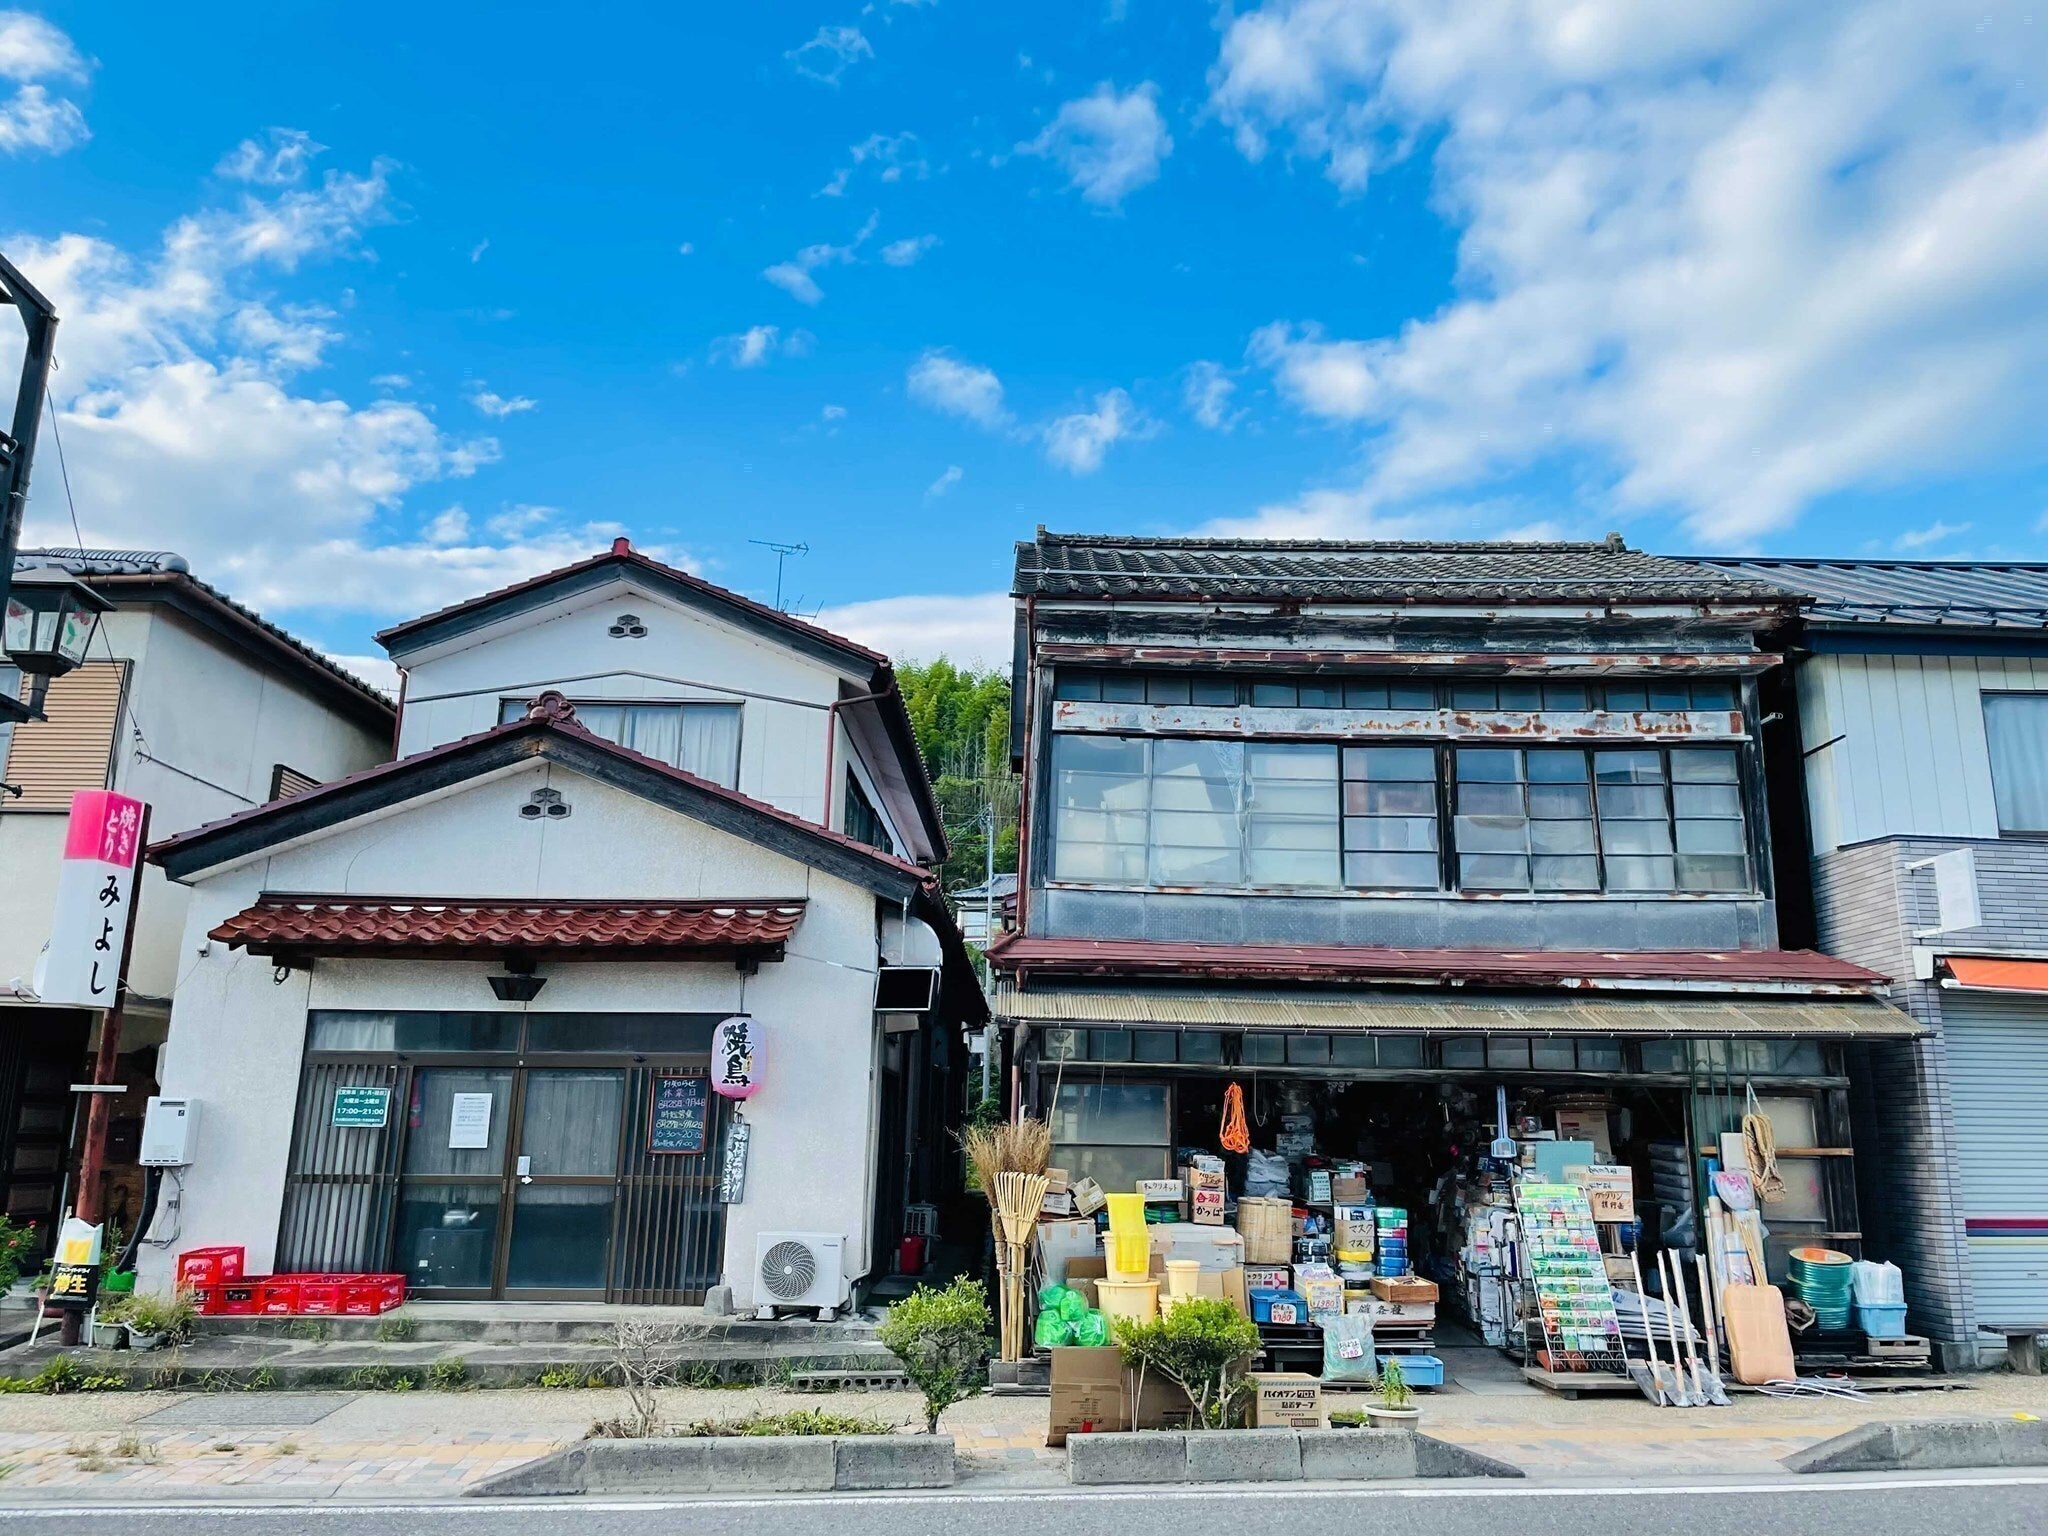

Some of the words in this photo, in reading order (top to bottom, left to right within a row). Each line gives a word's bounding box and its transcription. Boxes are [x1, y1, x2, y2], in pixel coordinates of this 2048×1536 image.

[104, 809, 119, 859] とり
[118, 804, 136, 855] 焼き
[90, 875, 120, 995] みよし
[721, 1022, 754, 1087] 焼鳥
[1196, 1192, 1220, 1203] 合羽
[1595, 1191, 1623, 1200] ガソリン
[1196, 1206, 1223, 1216] かっぱ
[1349, 1224, 1373, 1234] マスク
[1348, 1239, 1371, 1248] マスク
